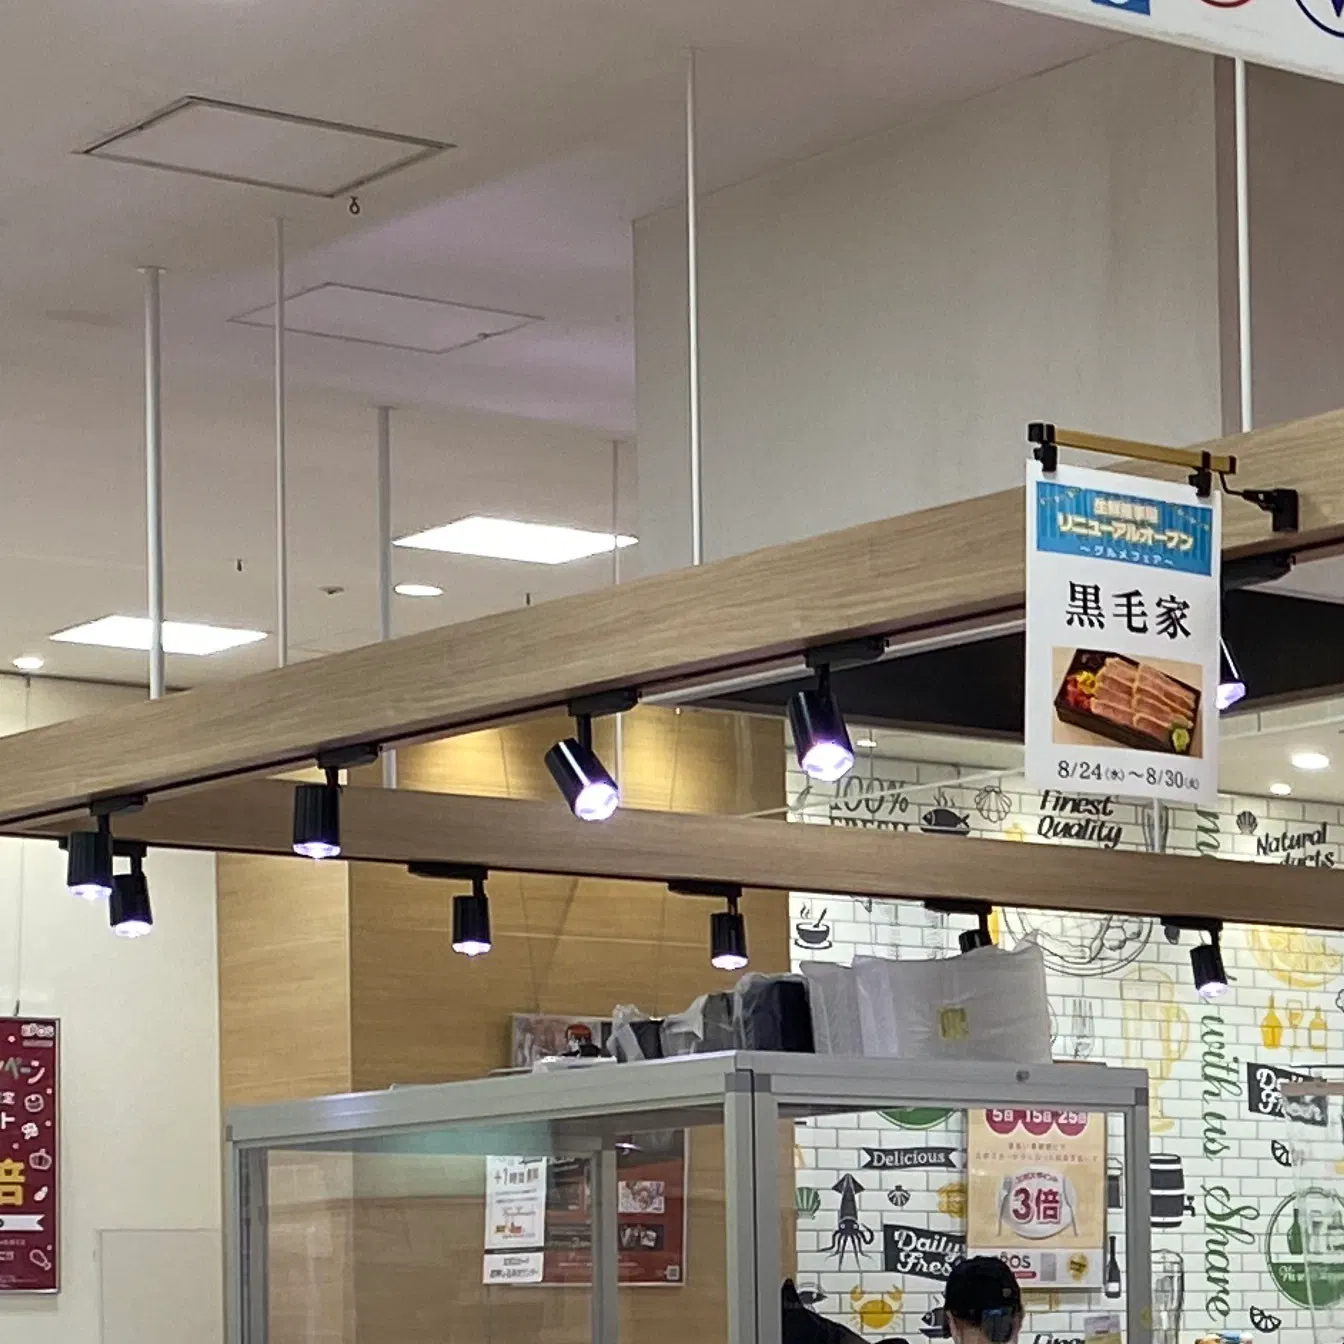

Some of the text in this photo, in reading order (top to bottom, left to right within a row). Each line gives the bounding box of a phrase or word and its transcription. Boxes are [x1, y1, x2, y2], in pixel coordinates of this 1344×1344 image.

[1057, 512, 1193, 551] リニューアルオープン
[1066, 581, 1191, 639] 黒毛家
[1037, 814, 1123, 850] Quality
[1257, 822, 1328, 855] Natural
[1201, 1014, 1243, 1105] with
[873, 1151, 946, 1167] Delicious
[1012, 1187, 1062, 1226] 3倍
[894, 1229, 960, 1262] Daily
[897, 1251, 953, 1276] Fres
[1200, 1185, 1260, 1322] Share
